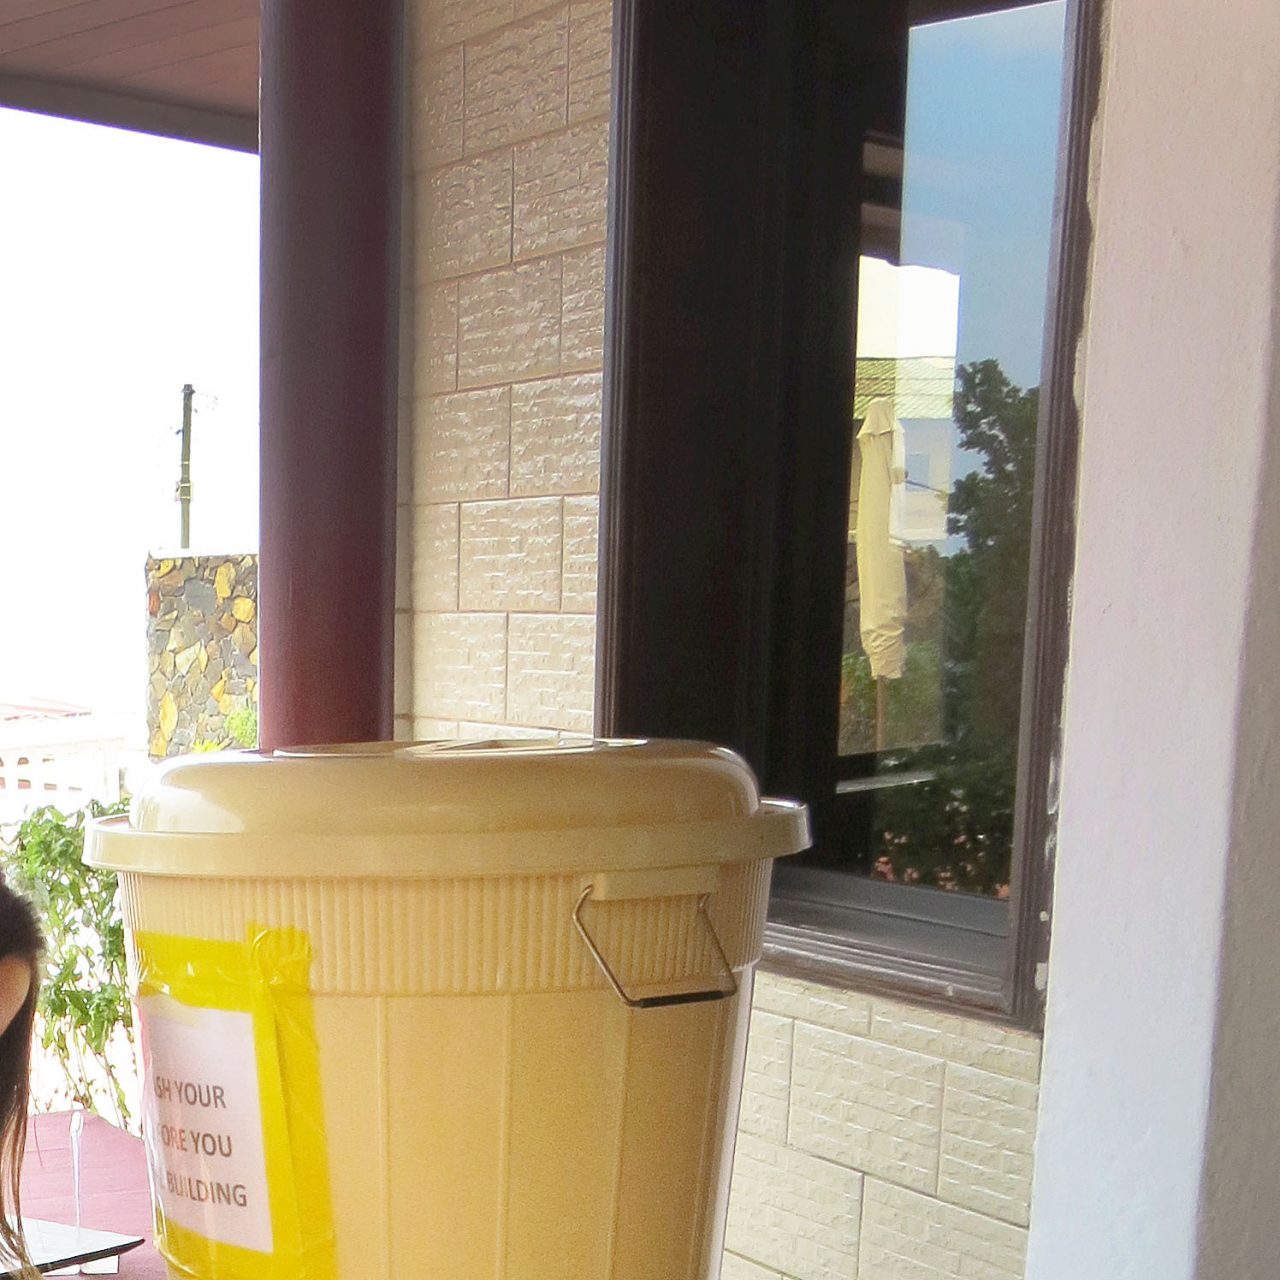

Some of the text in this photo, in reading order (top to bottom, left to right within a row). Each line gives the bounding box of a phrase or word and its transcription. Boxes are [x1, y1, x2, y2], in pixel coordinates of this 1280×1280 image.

[154, 1075, 227, 1109] SH YOUR
[160, 1124, 233, 1158] ORE YOU
[167, 1171, 248, 1208] BUILDING
